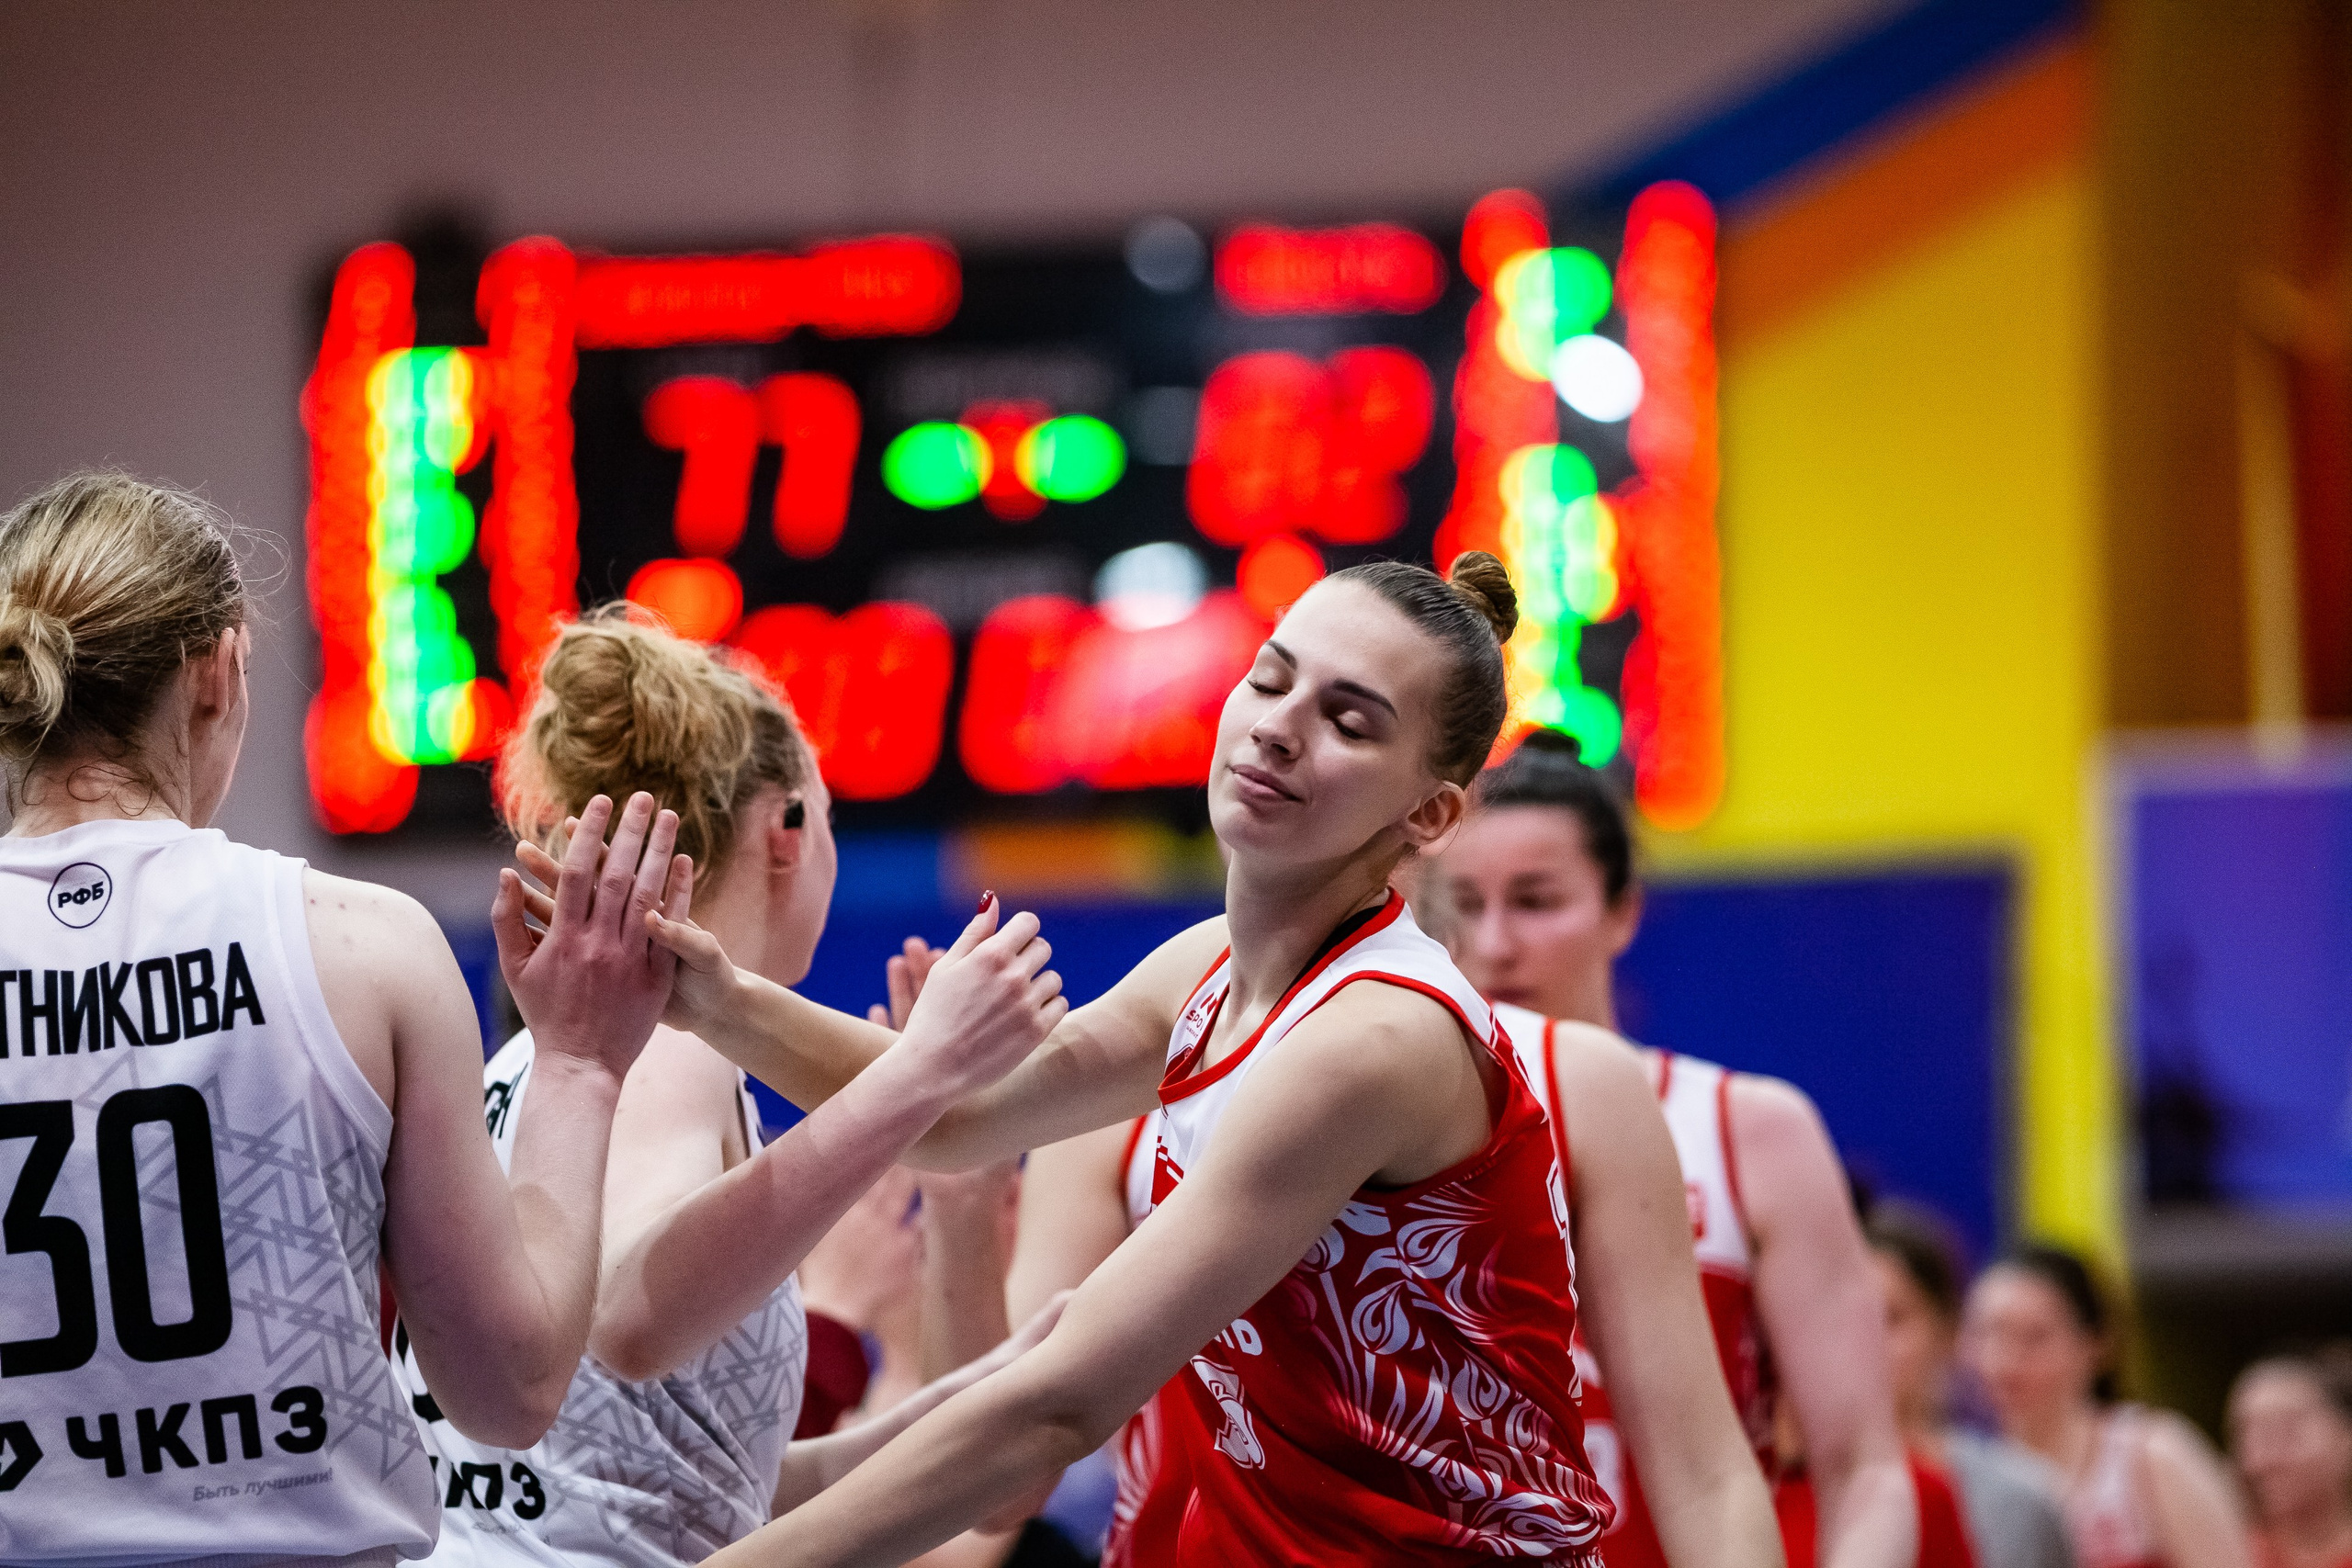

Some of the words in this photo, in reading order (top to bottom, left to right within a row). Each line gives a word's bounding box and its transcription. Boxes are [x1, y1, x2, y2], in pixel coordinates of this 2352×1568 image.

[57, 881, 105, 908] РФБ
[65, 1385, 328, 1479] ЧКПЗ
[193, 1484, 240, 1502] Быть
